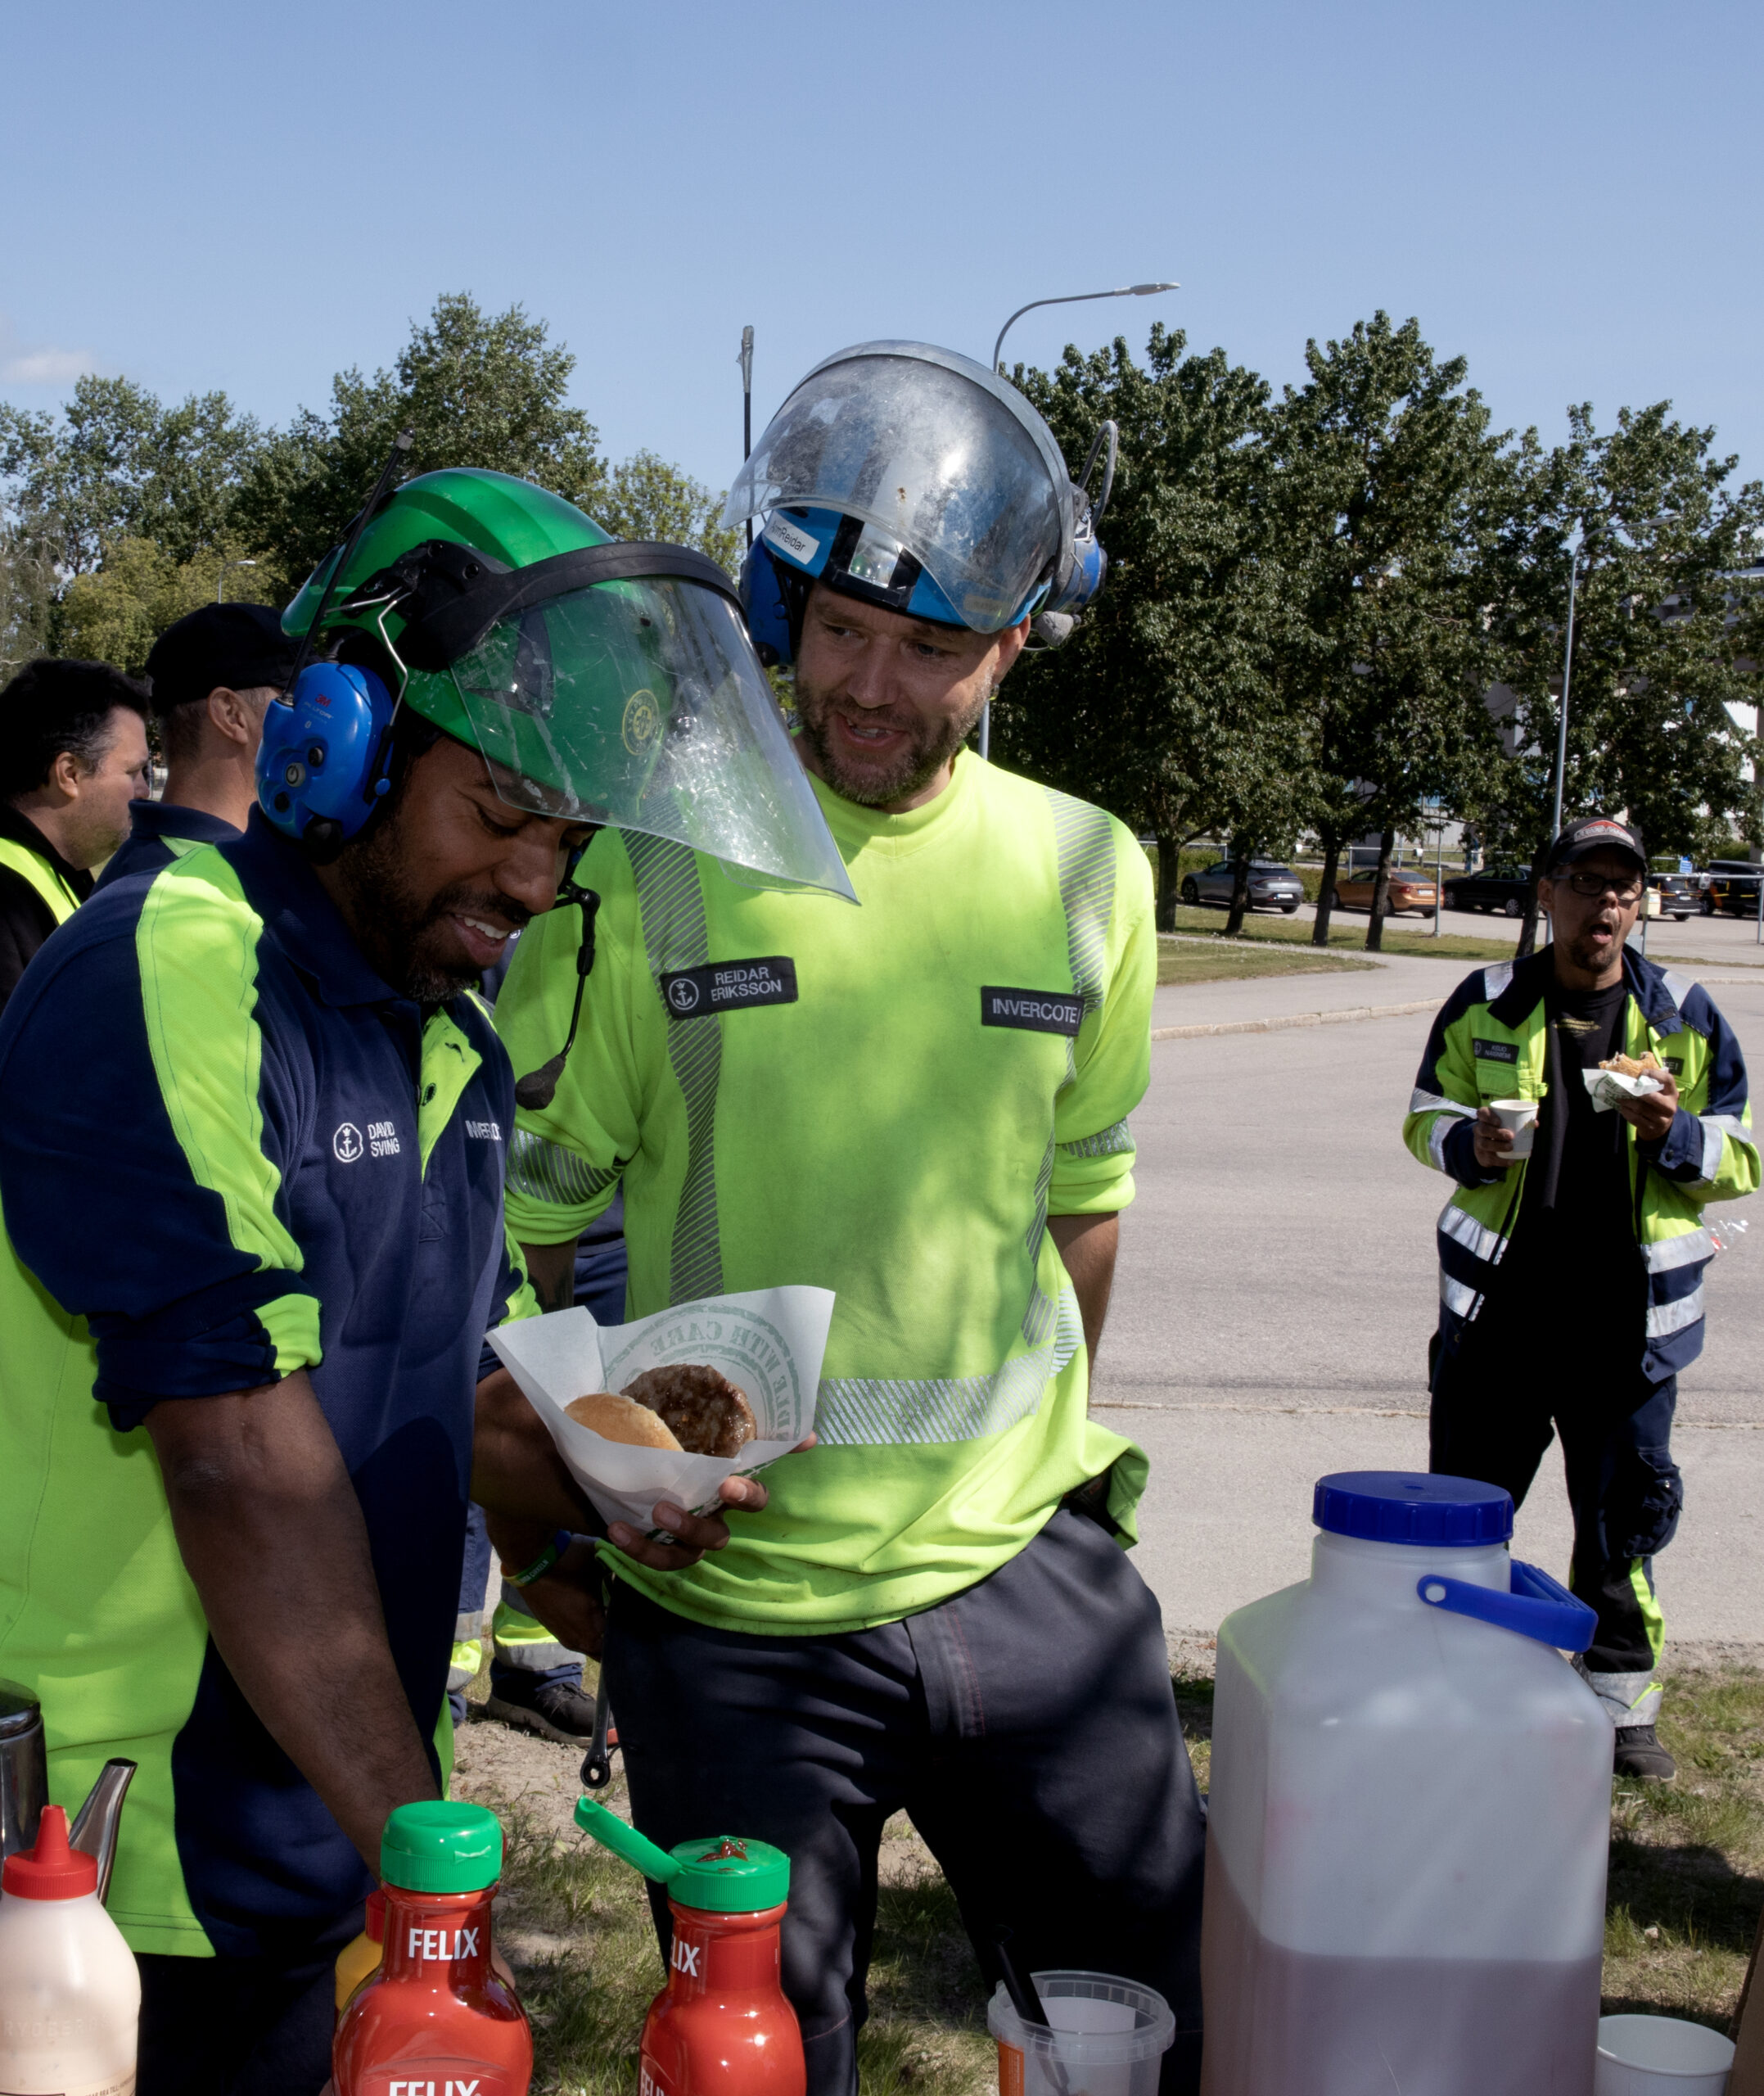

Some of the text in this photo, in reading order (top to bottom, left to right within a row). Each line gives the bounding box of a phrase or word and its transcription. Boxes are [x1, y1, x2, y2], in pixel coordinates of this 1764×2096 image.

[315, 694, 332, 707] 3M
[715, 967, 769, 986] REIDAR
[711, 979, 782, 1001] ERIKSSON
[367, 1121, 395, 1140] DAVID
[370, 1137, 400, 1157] SVING
[408, 1927, 479, 1960] FELIX
[670, 1934, 700, 1977] LIX
